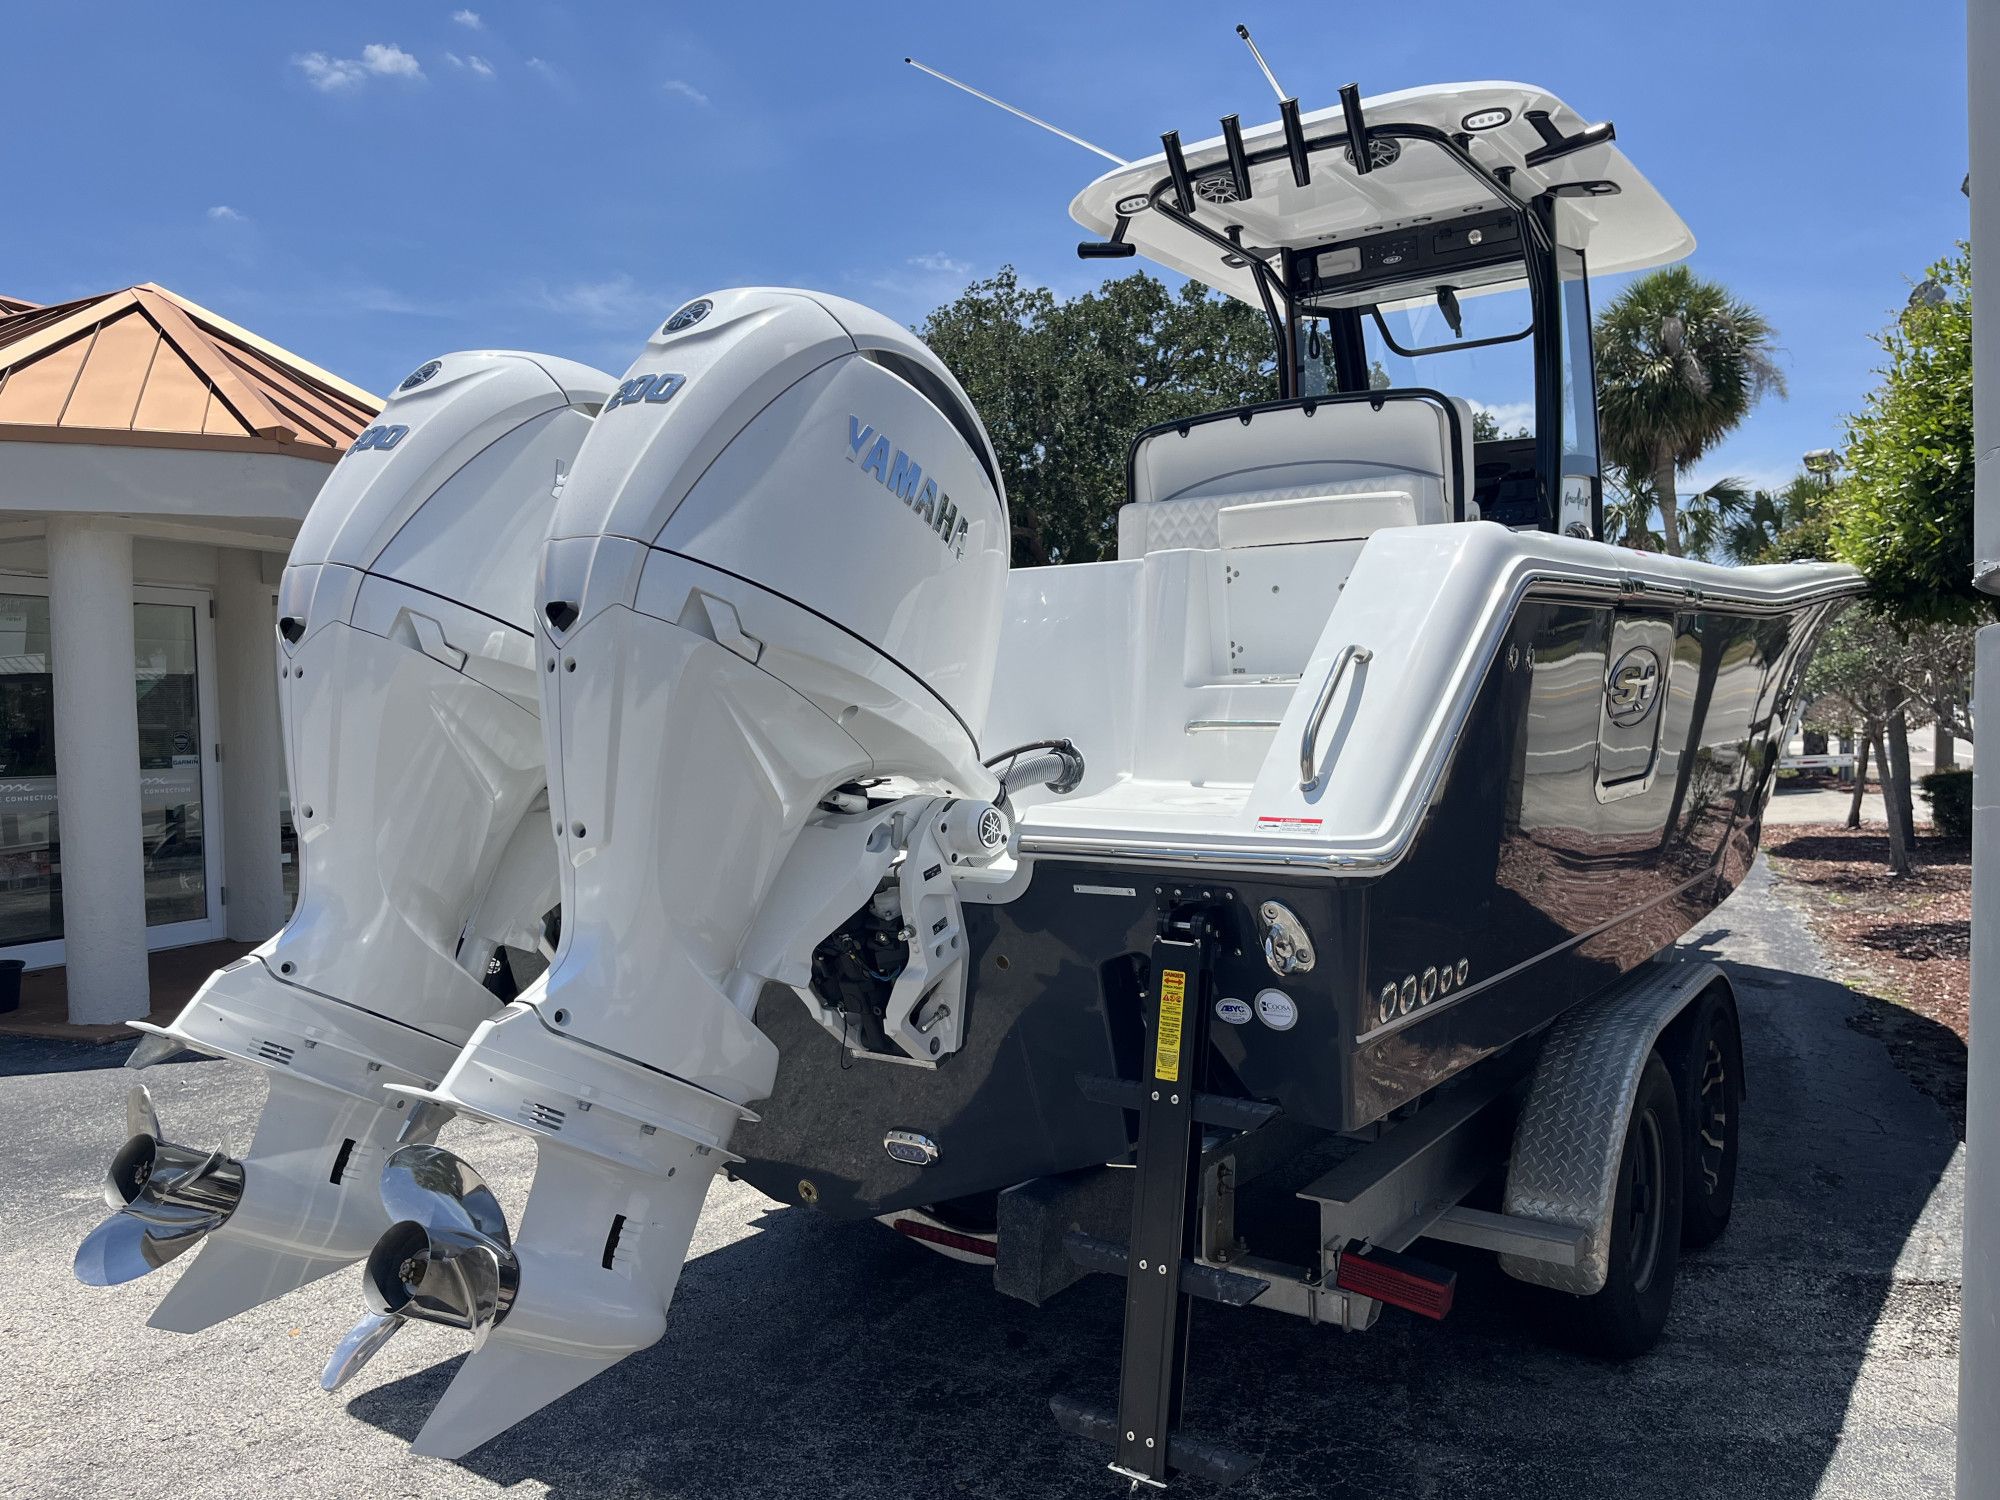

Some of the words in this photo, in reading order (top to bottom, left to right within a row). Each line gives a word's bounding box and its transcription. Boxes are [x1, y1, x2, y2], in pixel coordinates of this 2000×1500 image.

[845, 413, 970, 562] YAMAHA
[172, 758, 199, 766] GARMIN
[144, 786, 191, 795] CONNECTION
[1220, 1004, 1245, 1013] ABYC
